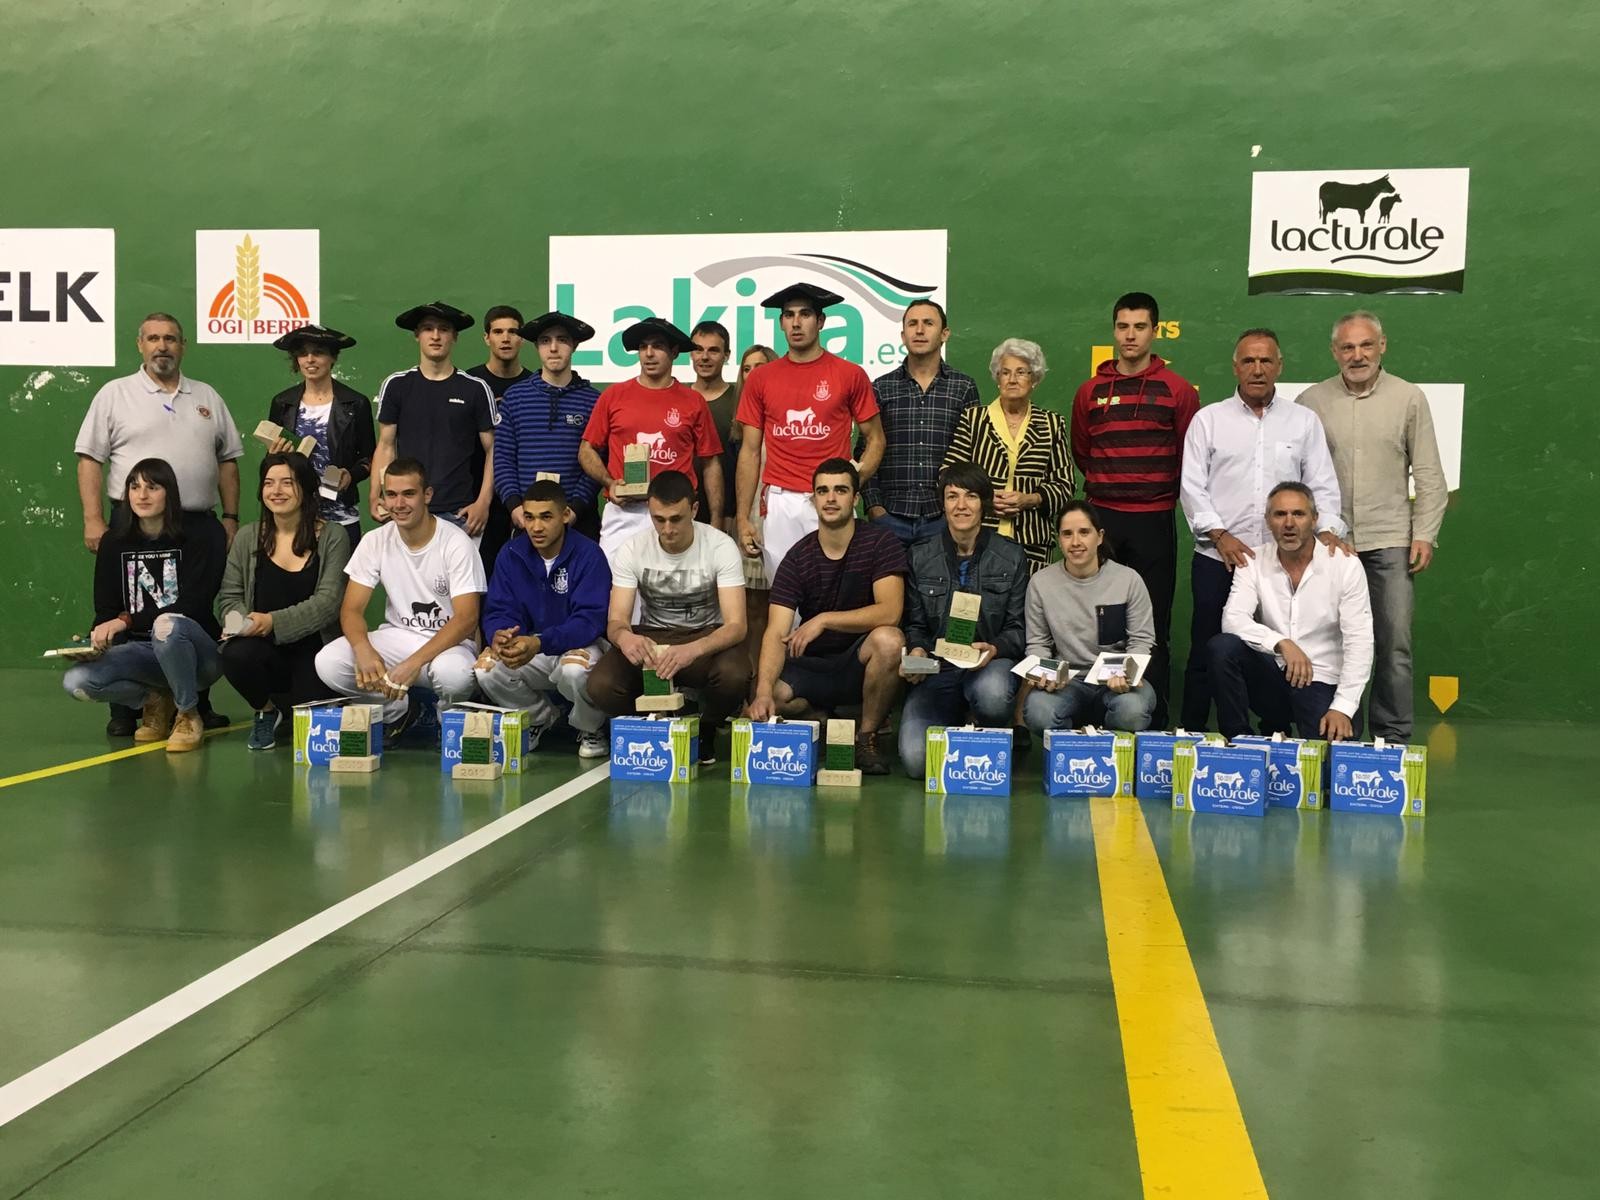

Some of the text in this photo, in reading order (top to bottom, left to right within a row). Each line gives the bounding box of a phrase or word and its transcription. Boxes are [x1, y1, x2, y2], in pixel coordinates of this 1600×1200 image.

[1271, 218, 1444, 251] lacturale
[208, 319, 242, 334] OGI
[773, 422, 831, 437] lacturale
[401, 616, 450, 628] actura
[312, 741, 340, 752] lactu
[614, 754, 668, 767] lacturale
[752, 758, 807, 772] lacturale
[948, 767, 1007, 781] lacturale
[1054, 771, 1112, 784] lacturale
[1140, 771, 1173, 784] lactu
[1197, 784, 1260, 800] lacturale
[1334, 783, 1399, 798] lacturale
